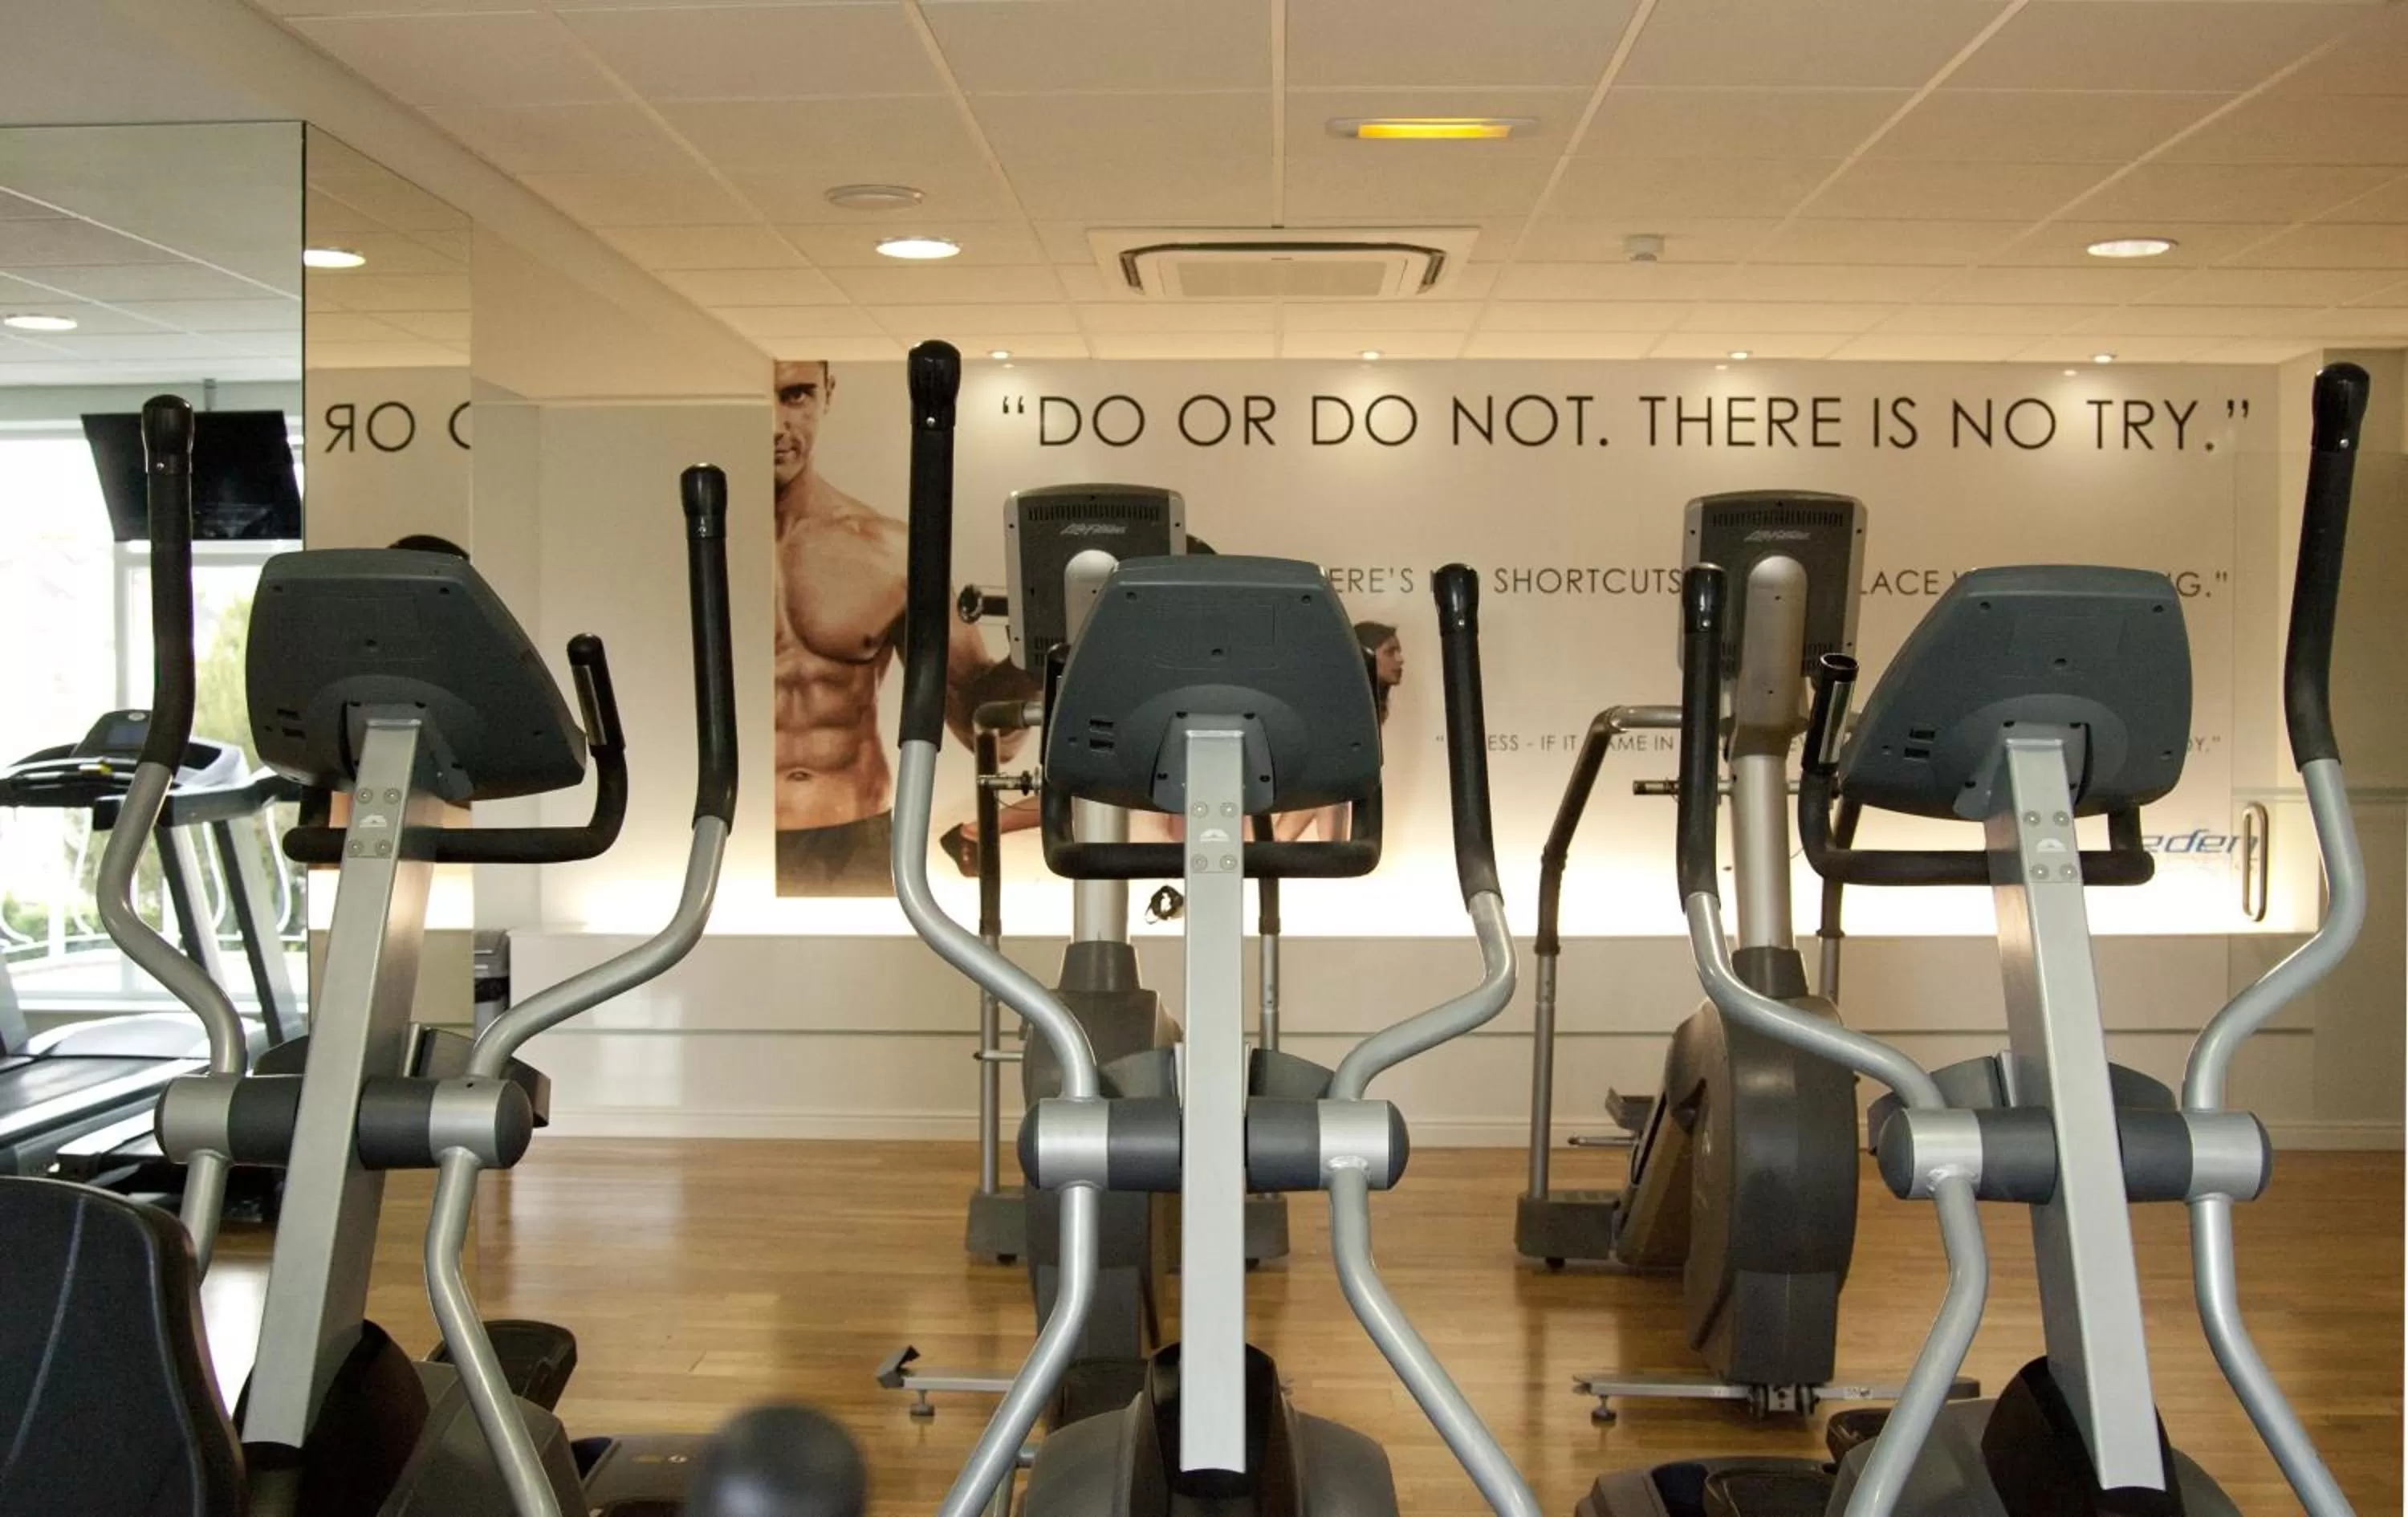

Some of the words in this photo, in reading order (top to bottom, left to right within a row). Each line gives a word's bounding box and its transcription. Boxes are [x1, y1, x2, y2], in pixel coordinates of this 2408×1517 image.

[1001, 394, 1146, 448] “DO
[1178, 394, 1276, 448] OR
[1311, 393, 1418, 447] DO
[1452, 394, 1609, 447] NOT.
[1638, 395, 1842, 448] THERE
[1873, 396, 1918, 450] IS
[1952, 397, 2057, 450] NO
[2085, 399, 2250, 452] TRY.”
[1328, 567, 1413, 594] ERE'S
[1494, 567, 1682, 595] SHORTCUTS
[1540, 734, 1556, 751] IF
[1563, 734, 1577, 751] IT
[1605, 734, 1647, 751] AME
[1653, 734, 1674, 751] IN
